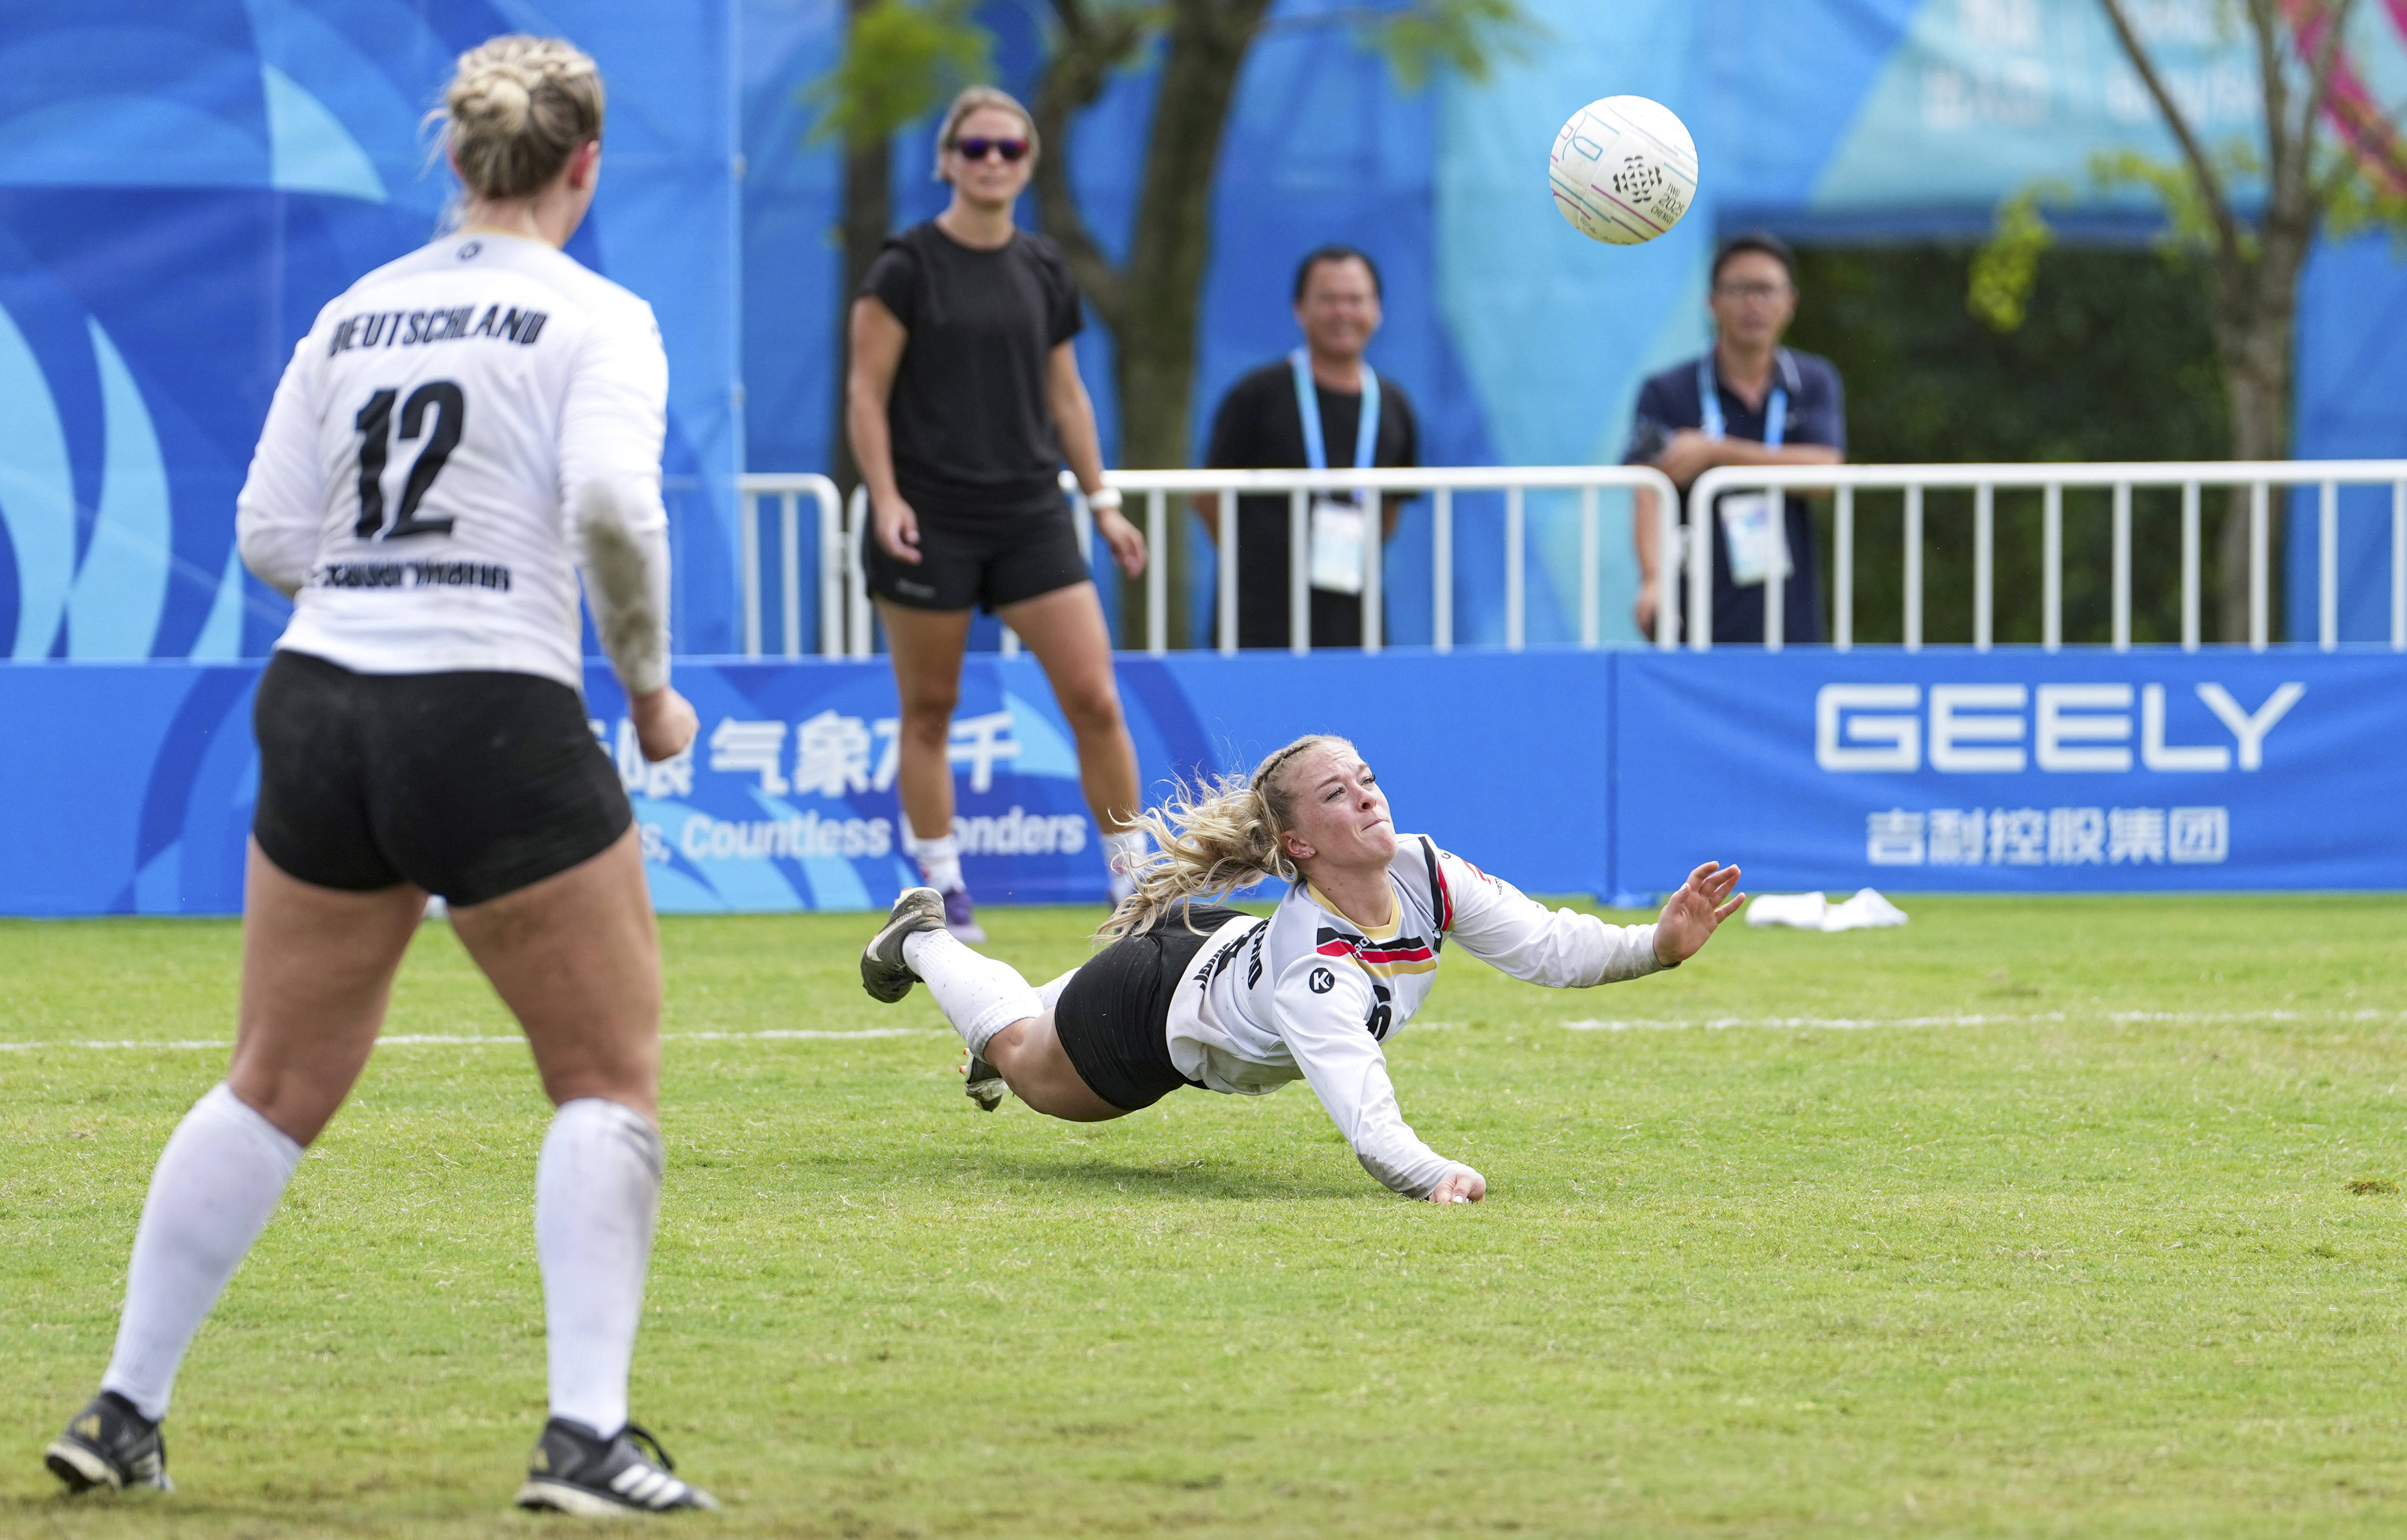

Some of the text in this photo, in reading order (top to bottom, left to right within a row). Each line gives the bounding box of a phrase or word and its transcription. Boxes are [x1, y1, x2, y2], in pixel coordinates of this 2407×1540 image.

[1658, 192, 1686, 217] 2025
[355, 381, 465, 539] 12
[1815, 682, 2306, 773] GEELY
[682, 809, 892, 858] Countless
[898, 806, 1088, 855] onders
[1866, 805, 2230, 866] 吉利控股集团
[1365, 984, 1392, 1042] 6
